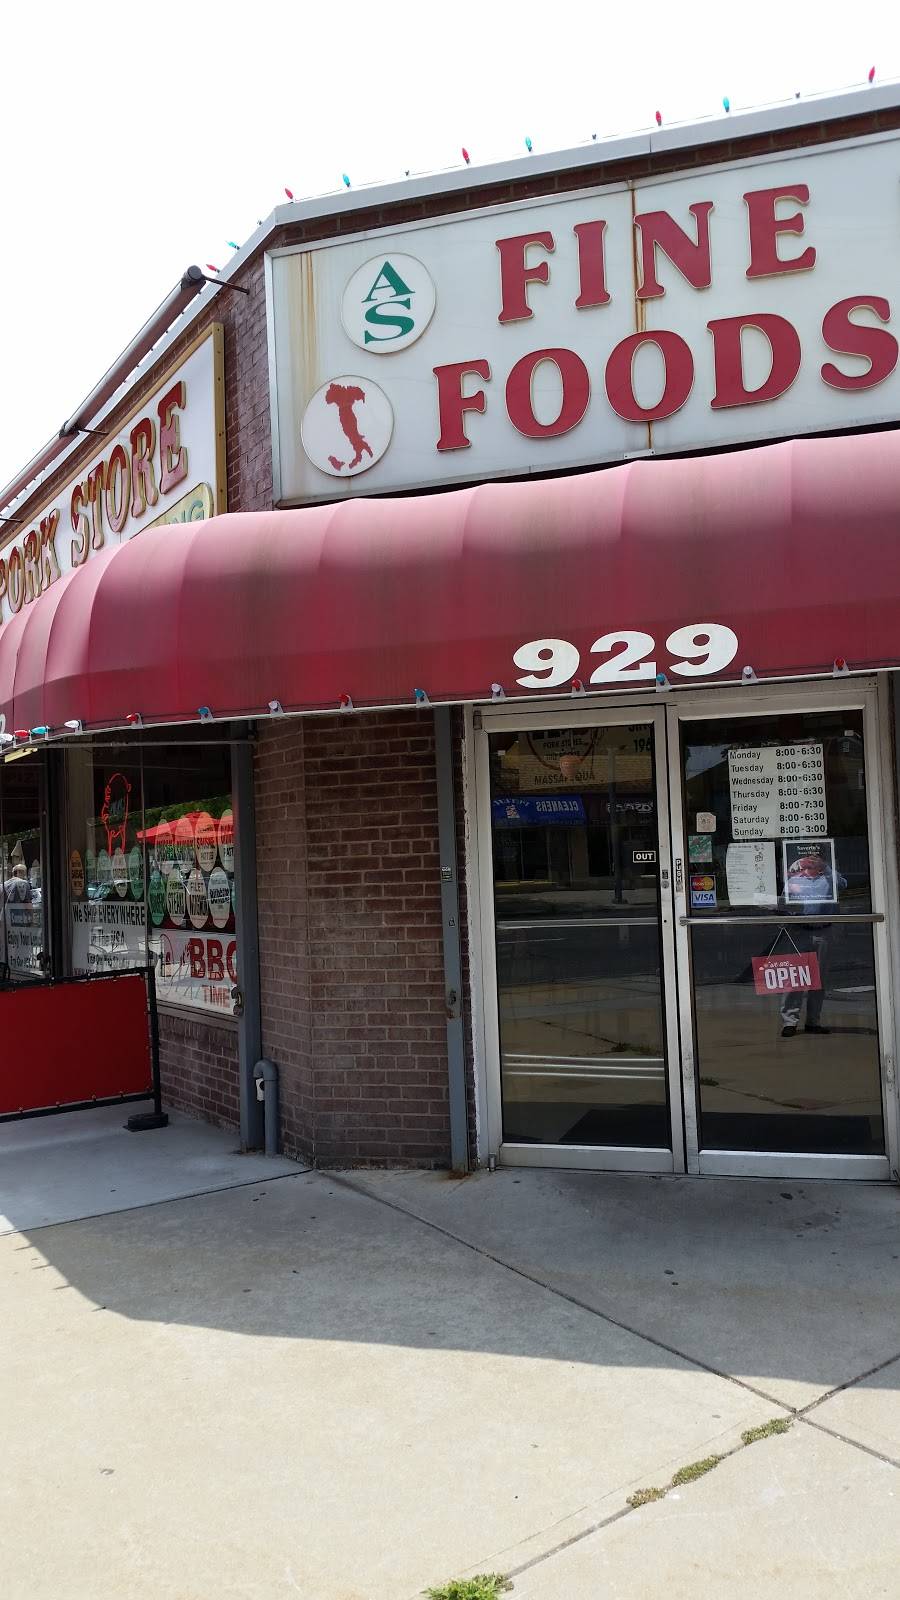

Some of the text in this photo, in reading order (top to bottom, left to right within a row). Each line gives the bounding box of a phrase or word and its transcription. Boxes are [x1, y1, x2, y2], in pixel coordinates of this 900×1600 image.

[495, 184, 817, 324] FINE
[433, 295, 899, 452] FOODS
[0, 380, 188, 626] PORK STORE
[513, 623, 739, 689] 929
[729, 751, 760, 760] Monday
[730, 764, 764, 772] Tuesday
[731, 777, 774, 785] Wednesday
[732, 790, 770, 798] Thursday
[732, 804, 758, 812] Friday
[733, 816, 770, 824] Saturday
[734, 828, 764, 836] Sunday
[694, 893, 715, 901] VISA
[73, 905, 83, 922] We
[99, 904, 146, 926] EVERYWHERE
[764, 966, 812, 990] OPEN
[201, 984, 230, 1009] TIME
